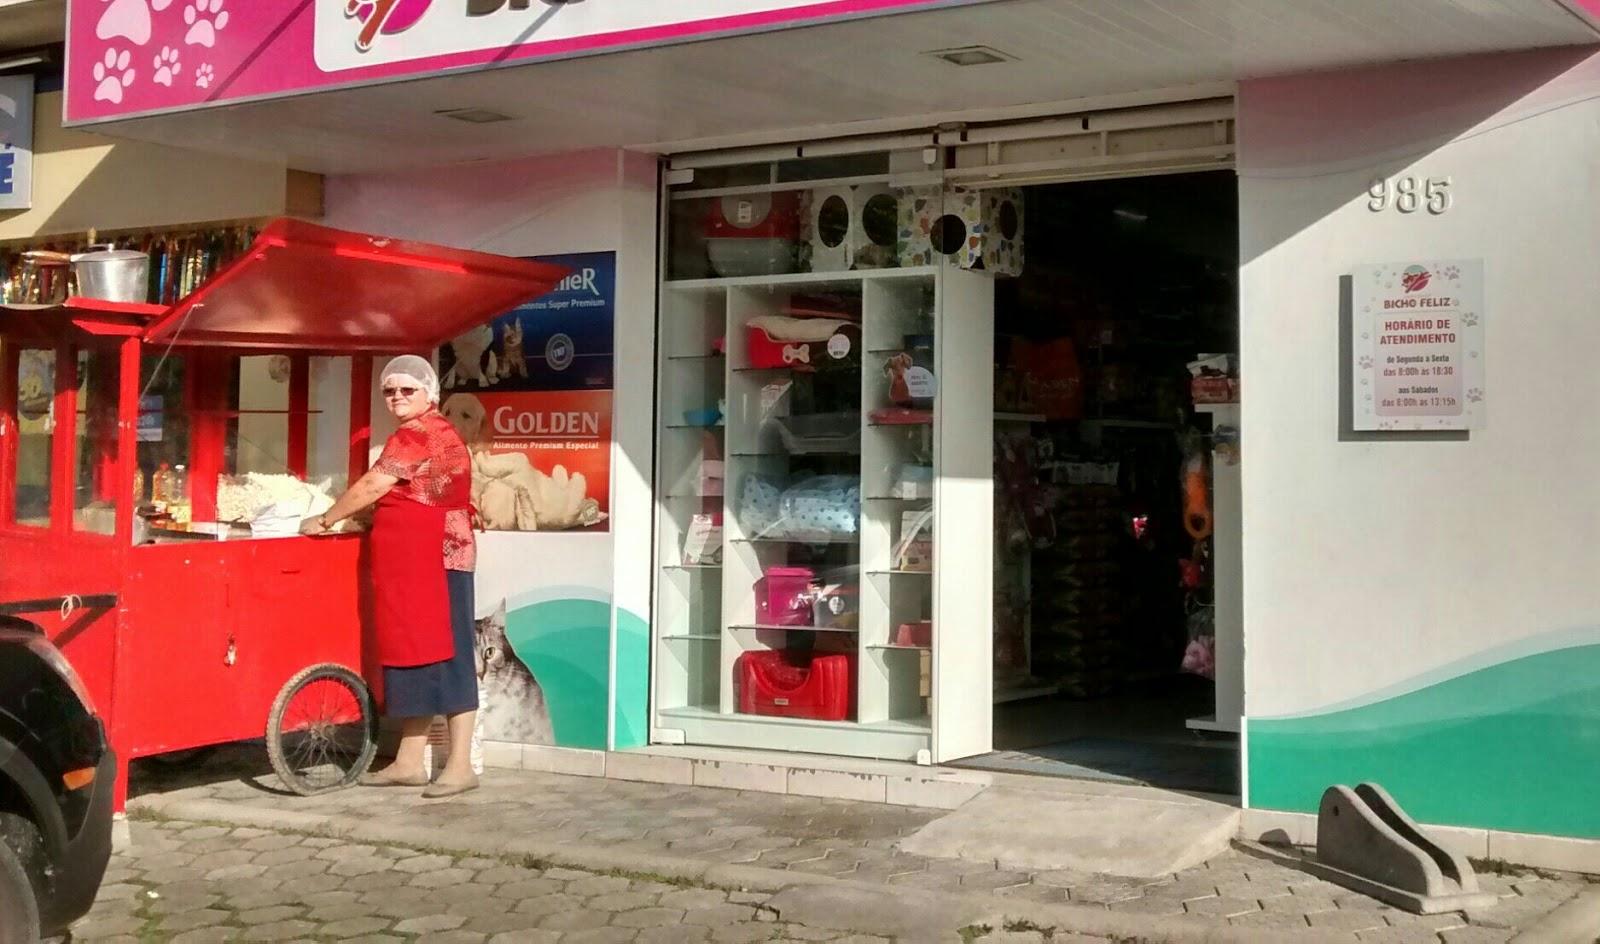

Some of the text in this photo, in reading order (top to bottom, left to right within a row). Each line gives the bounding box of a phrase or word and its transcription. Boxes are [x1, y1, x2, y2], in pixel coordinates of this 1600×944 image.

[1368, 176, 1452, 215] 985
[549, 301, 569, 311] Super
[571, 299, 605, 308] Premium
[1384, 297, 1450, 309] BICHO FELIZ
[1437, 319, 1450, 329] DE
[1380, 333, 1456, 345] ATENDIMENTO
[1387, 355, 1395, 363] de
[1396, 356, 1424, 364] Segunda
[1383, 367, 1396, 376] das
[1382, 398, 1394, 407] das
[493, 406, 599, 434] GOLDEN
[493, 441, 599, 452] Alimento Premium Especial
